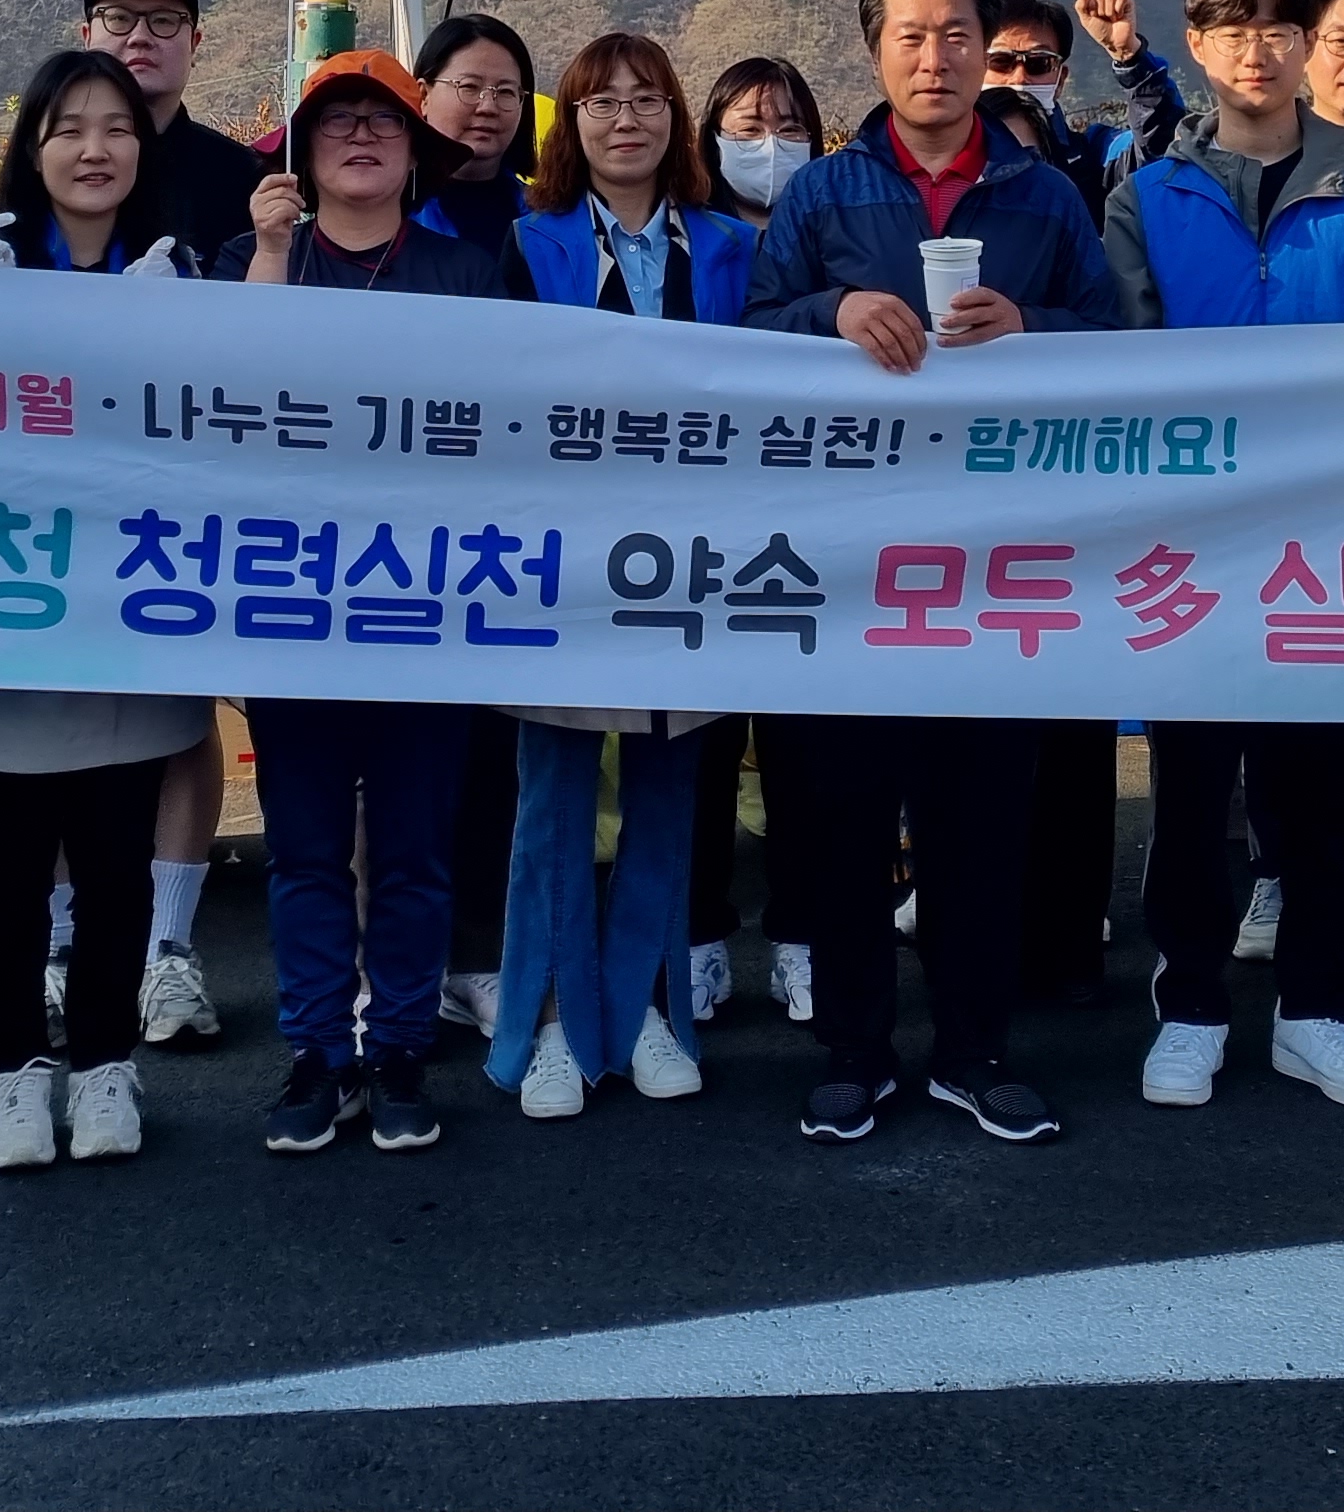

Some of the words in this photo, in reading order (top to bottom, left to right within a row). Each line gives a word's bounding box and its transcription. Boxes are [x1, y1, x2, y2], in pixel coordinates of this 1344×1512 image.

[143, 381, 333, 451] 나누는
[355, 393, 483, 458] 기쁨
[547, 402, 739, 465] 행복한
[758, 414, 906, 468] 실천!
[964, 414, 1239, 476] 함께해요!
[114, 508, 563, 648] 청렴실천
[607, 531, 827, 656] 약속
[862, 543, 1083, 659] 모두
[1113, 543, 1222, 653] 多
